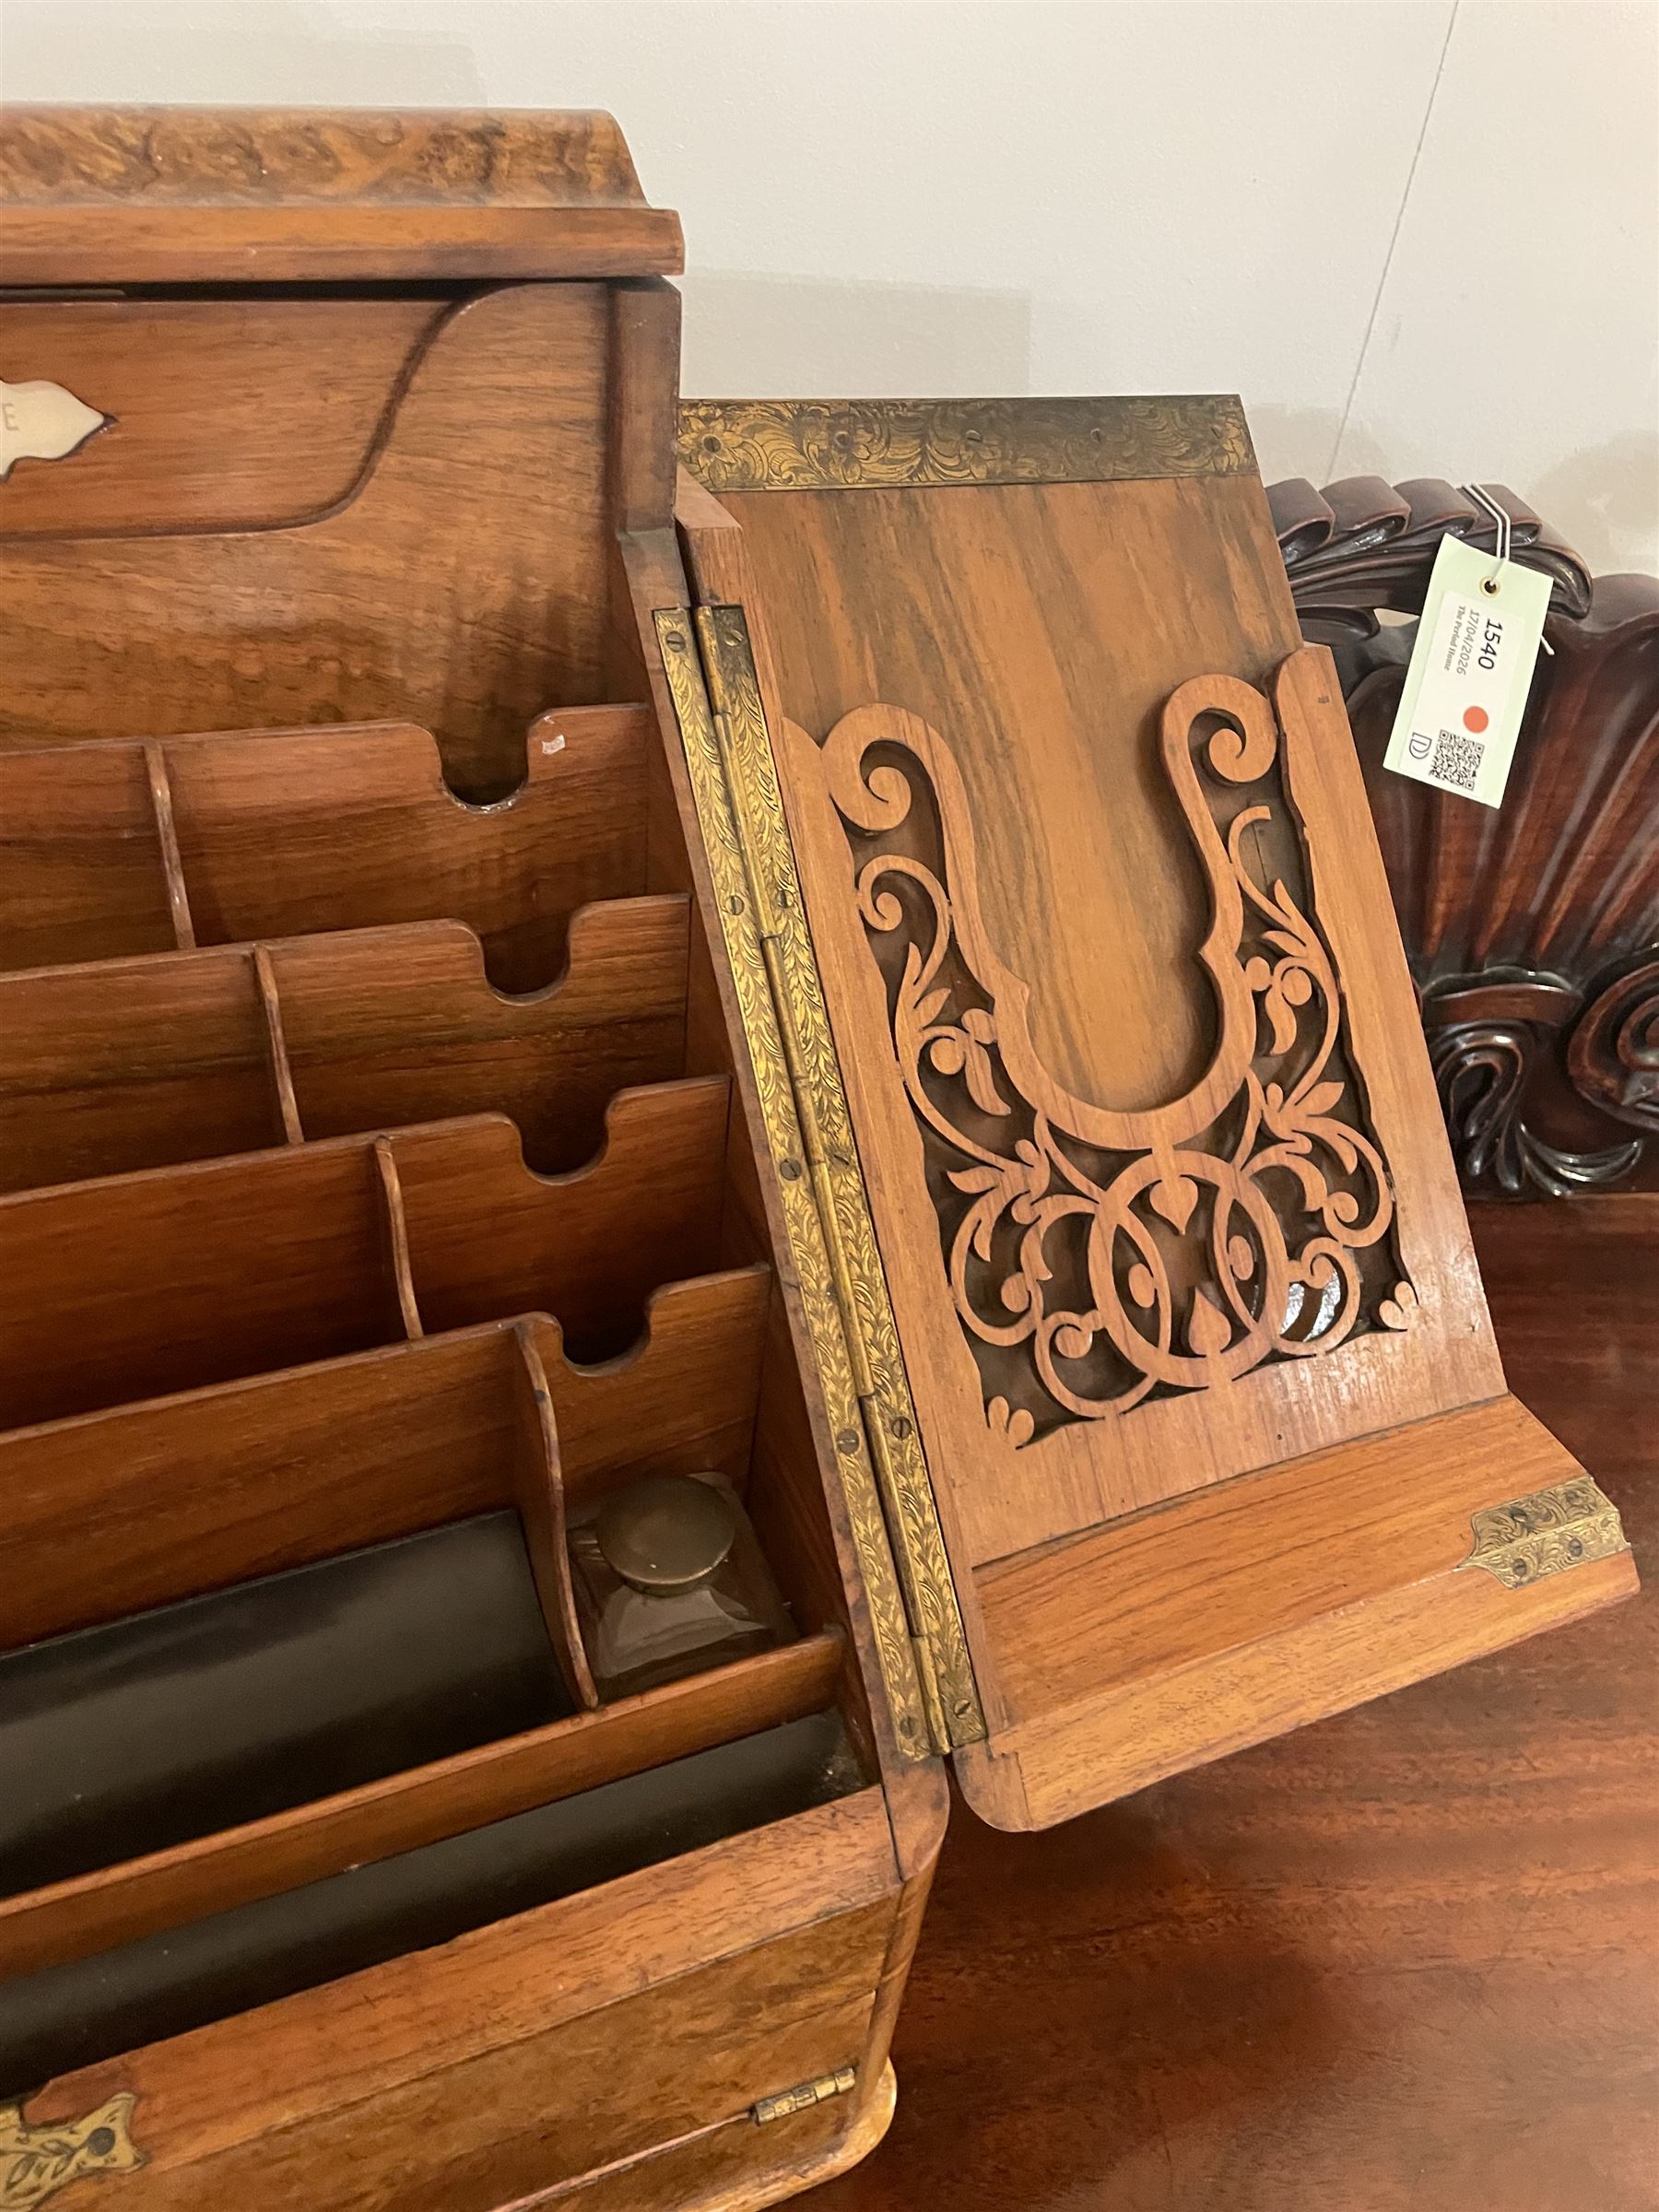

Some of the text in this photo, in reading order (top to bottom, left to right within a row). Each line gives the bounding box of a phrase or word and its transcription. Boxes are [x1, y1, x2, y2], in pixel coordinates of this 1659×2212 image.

[1443, 606, 1466, 671] The Period Home
[1456, 608, 1480, 676] 17/04/2026
[1477, 618, 1503, 670] 1540
